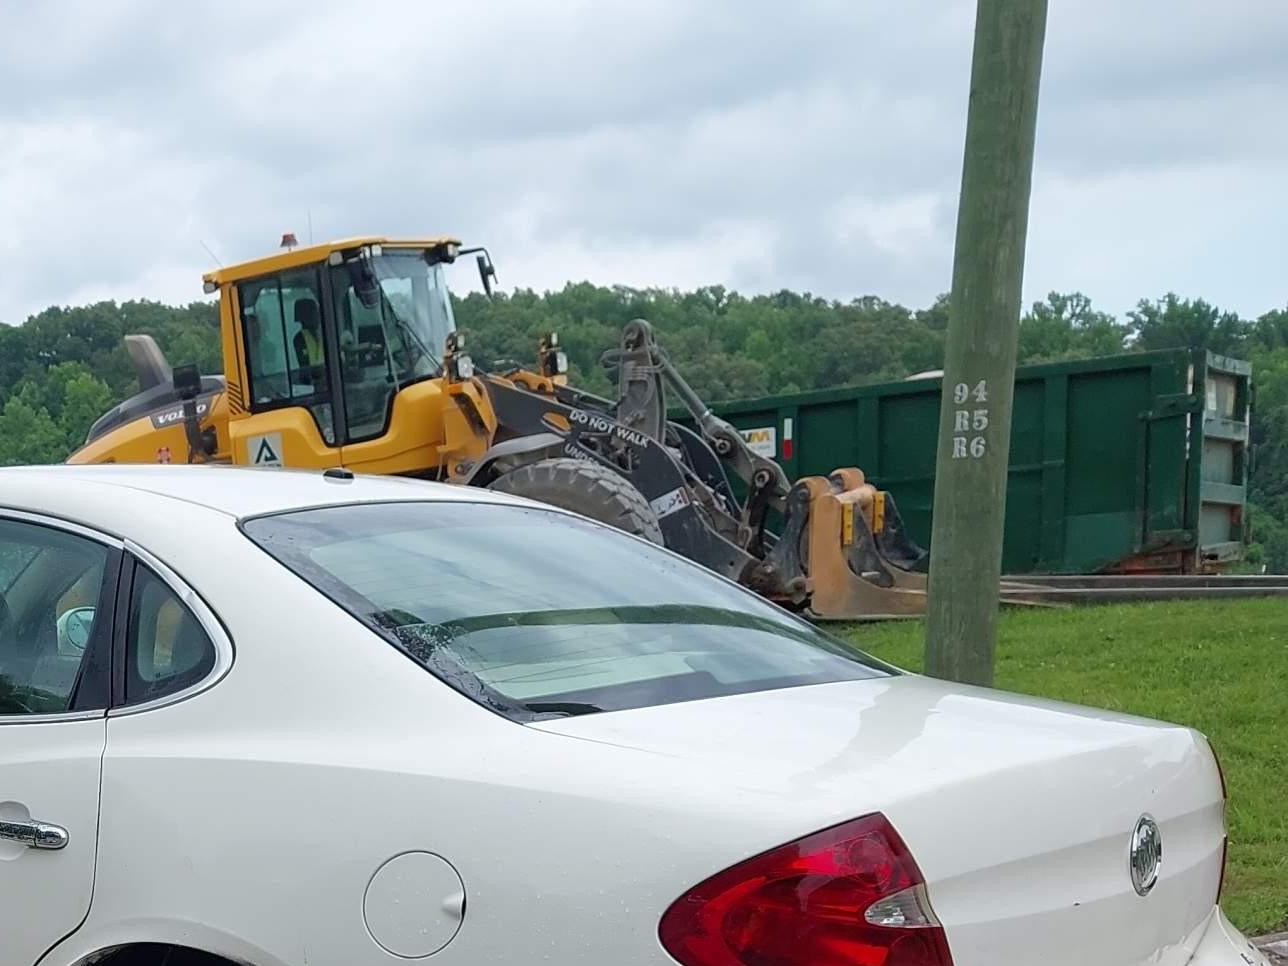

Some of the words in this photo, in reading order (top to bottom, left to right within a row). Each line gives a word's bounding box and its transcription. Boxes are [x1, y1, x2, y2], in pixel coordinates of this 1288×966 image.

[954, 380, 988, 404] 94
[158, 404, 207, 424] VOLO
[954, 409, 989, 432] R5
[569, 409, 589, 424] DO
[588, 417, 615, 434] NOT
[616, 427, 649, 448] WALK
[564, 443, 599, 465] UND
[952, 436, 986, 459] R6
